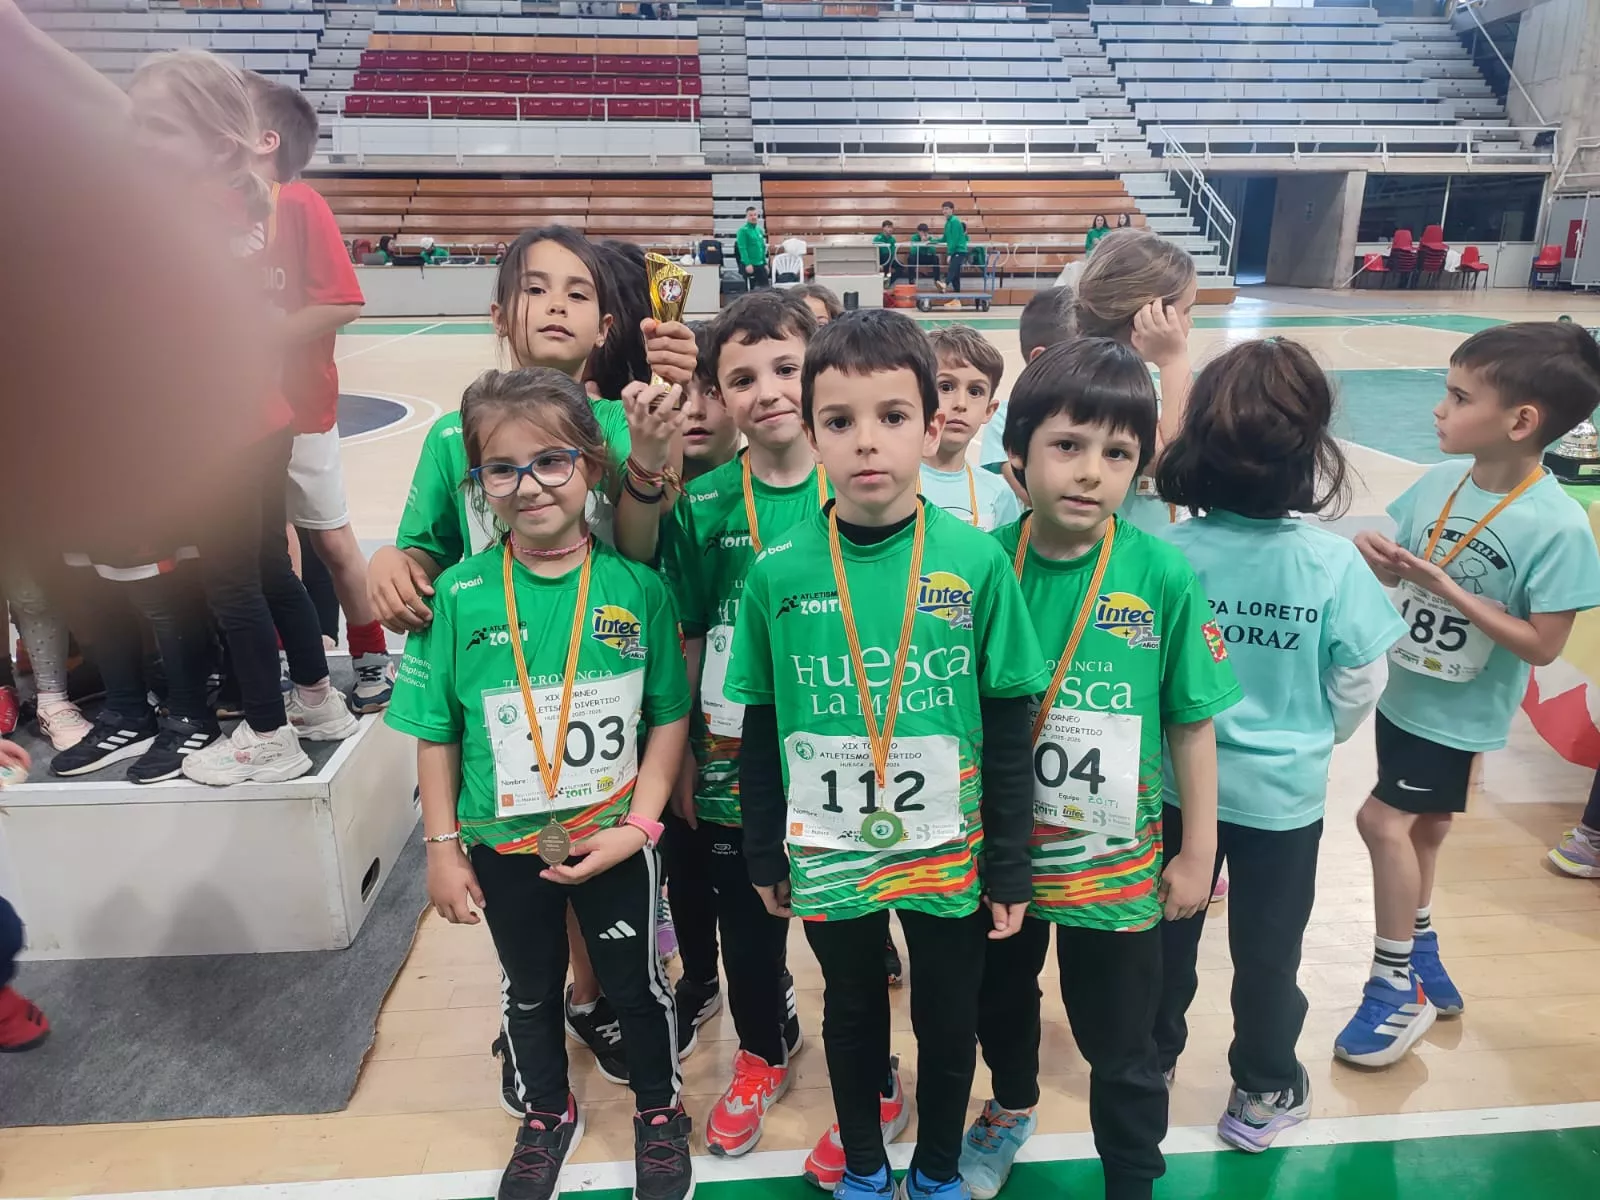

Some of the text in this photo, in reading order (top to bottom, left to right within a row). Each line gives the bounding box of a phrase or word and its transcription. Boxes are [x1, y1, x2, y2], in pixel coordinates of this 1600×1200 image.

[697, 490, 718, 501] barri
[768, 541, 792, 555] barri
[459, 575, 483, 590] barri
[801, 591, 838, 600] ATLETISM
[920, 576, 973, 605] intec
[1098, 595, 1154, 623] intec
[1237, 601, 1318, 623] LORETO
[593, 608, 641, 634] intec
[1219, 625, 1300, 650] ORAZ
[545, 694, 561, 702] XIX
[574, 695, 621, 710] DIVERTIDO
[811, 693, 847, 715] La
[1055, 725, 1103, 736] DIVERTIDO
[841, 742, 858, 750] XIX
[820, 752, 922, 760] ATLETISMO ERTIDO
[565, 787, 593, 799] ZOITI
[821, 769, 926, 814] 112
